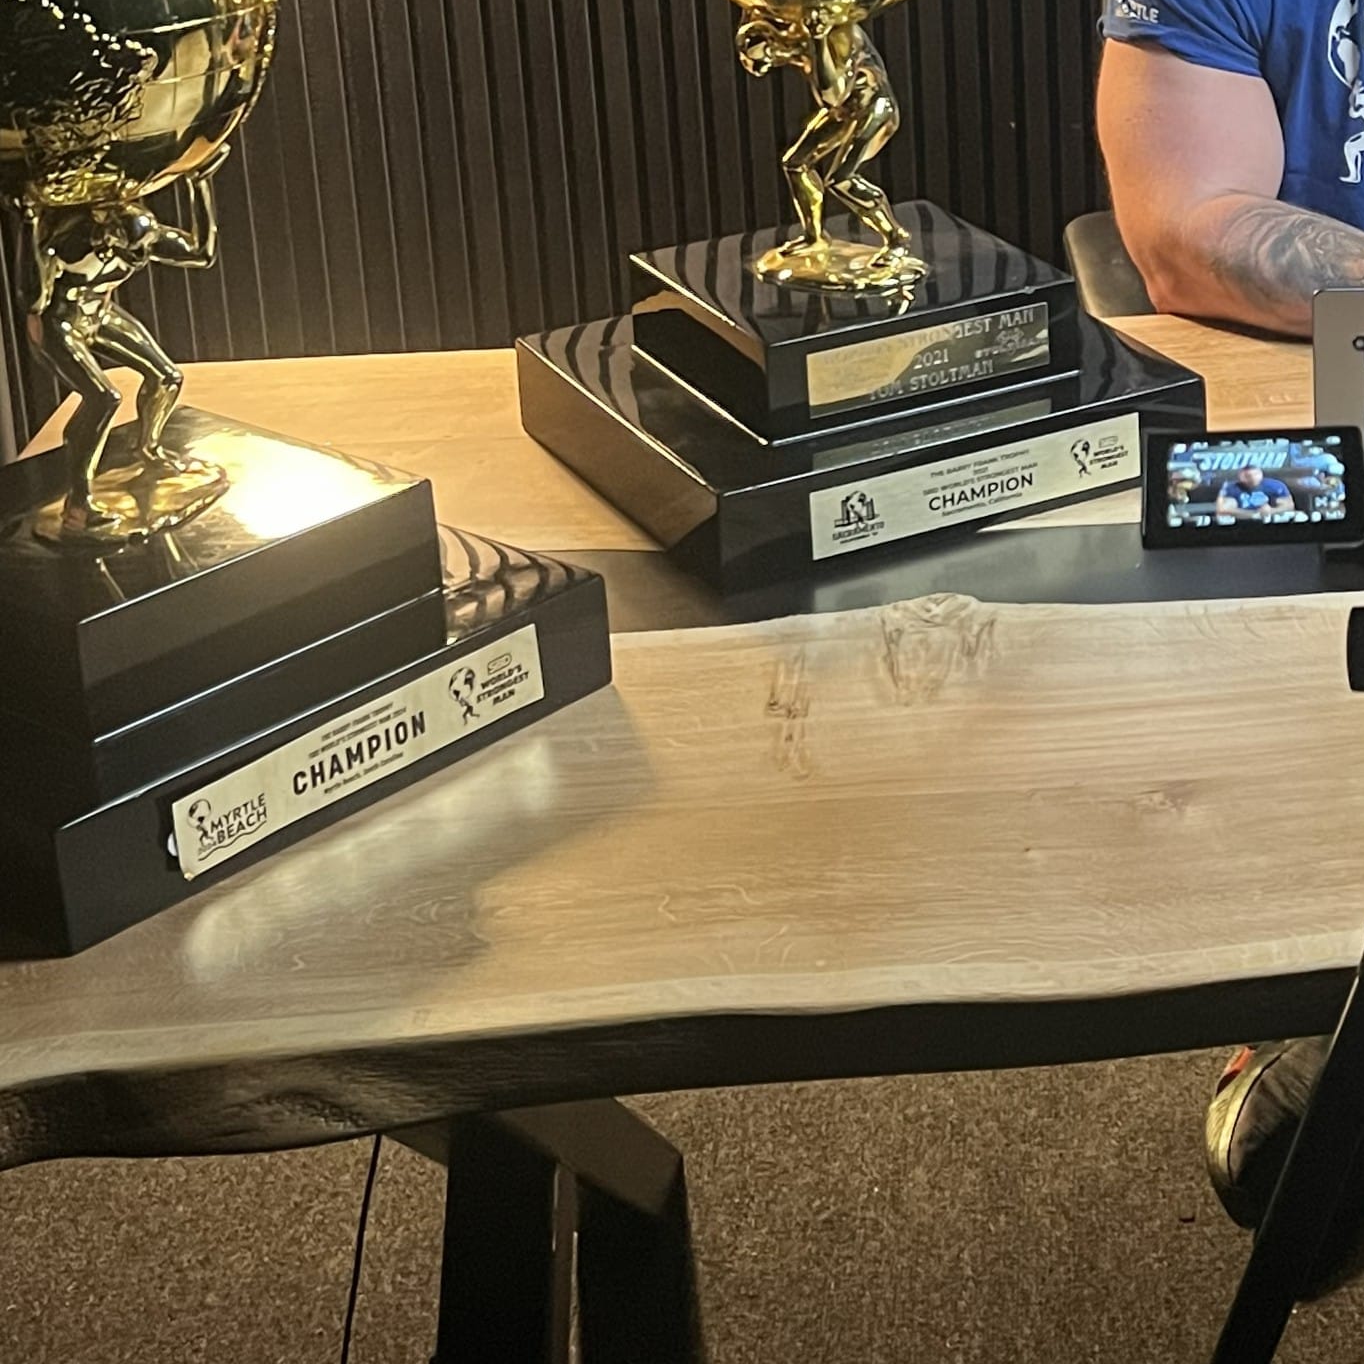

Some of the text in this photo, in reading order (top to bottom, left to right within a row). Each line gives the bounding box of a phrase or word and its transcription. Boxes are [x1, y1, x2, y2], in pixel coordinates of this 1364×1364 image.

[998, 308, 1035, 330] MAN
[913, 348, 950, 370] 2021
[870, 359, 994, 401] TOM STOLTMAN
[928, 472, 1034, 511] CHAMPION
[832, 521, 885, 541] SACRAMENTO
[476, 670, 529, 703] STRONGEST
[492, 688, 516, 705] MAN
[292, 710, 426, 796] CHAMPION
[210, 792, 267, 834] MYRTLE
[217, 805, 268, 845] BEACH
